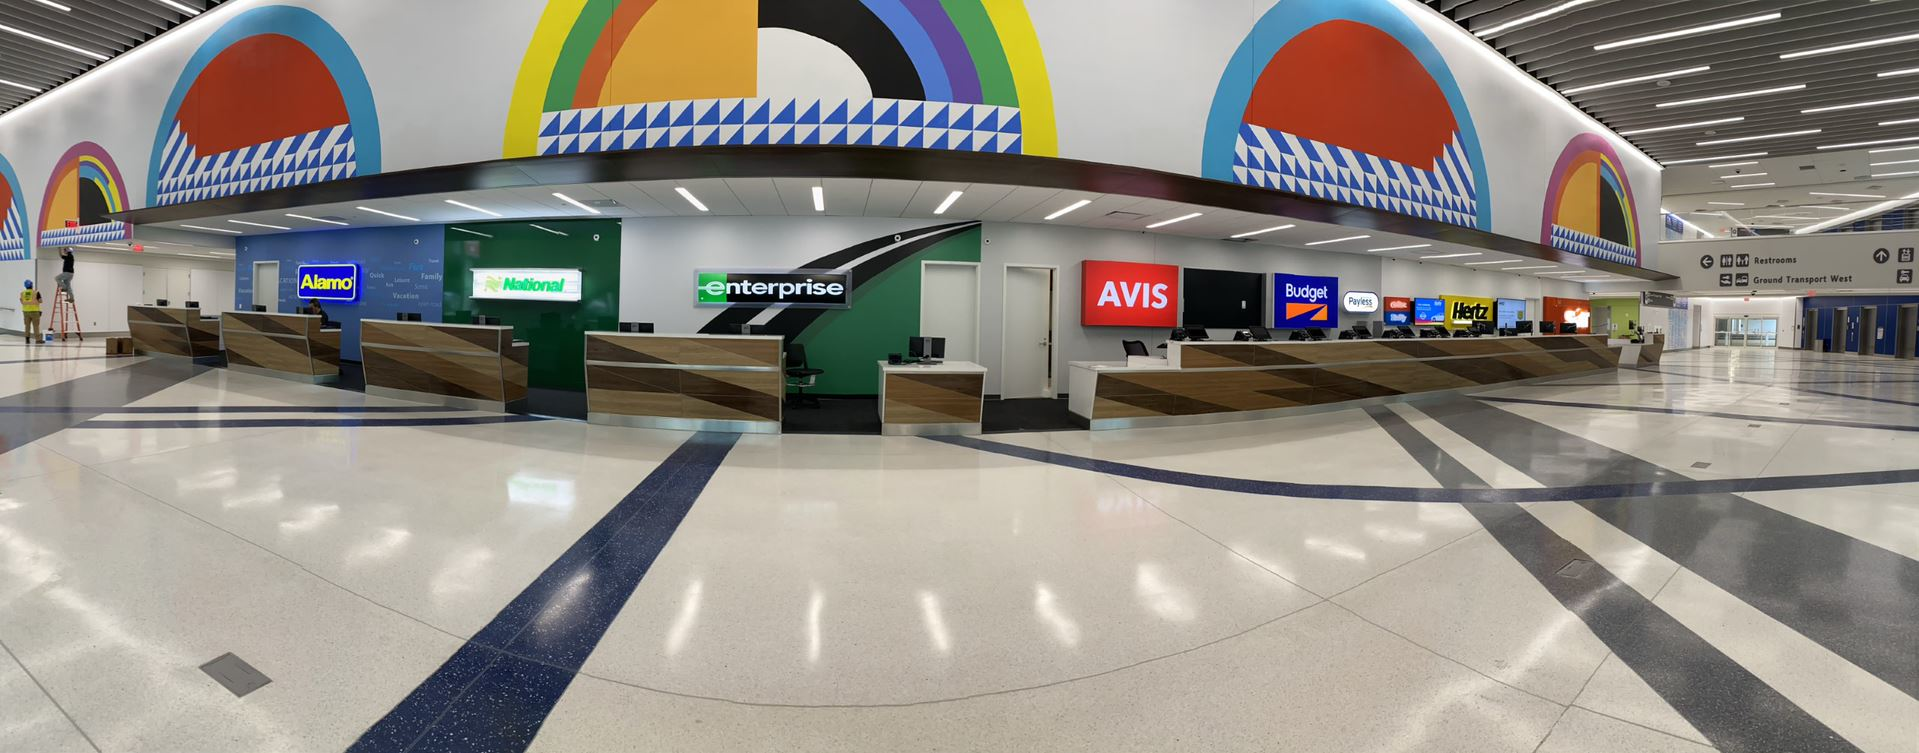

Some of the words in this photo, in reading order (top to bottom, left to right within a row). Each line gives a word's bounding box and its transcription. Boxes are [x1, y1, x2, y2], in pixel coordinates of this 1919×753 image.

[300, 274, 353, 291] Alamo
[420, 272, 443, 282] Family
[503, 277, 565, 292] National
[1753, 276, 1783, 284] Ground
[1786, 275, 1827, 284] Transport
[1830, 274, 1853, 283] West
[392, 291, 419, 300] Vacation
[699, 279, 844, 299] enterprise
[1097, 281, 1169, 309] AVIS
[1286, 283, 1328, 303] Budget
[1348, 297, 1373, 307] Payless
[1453, 302, 1489, 320] Hertz
